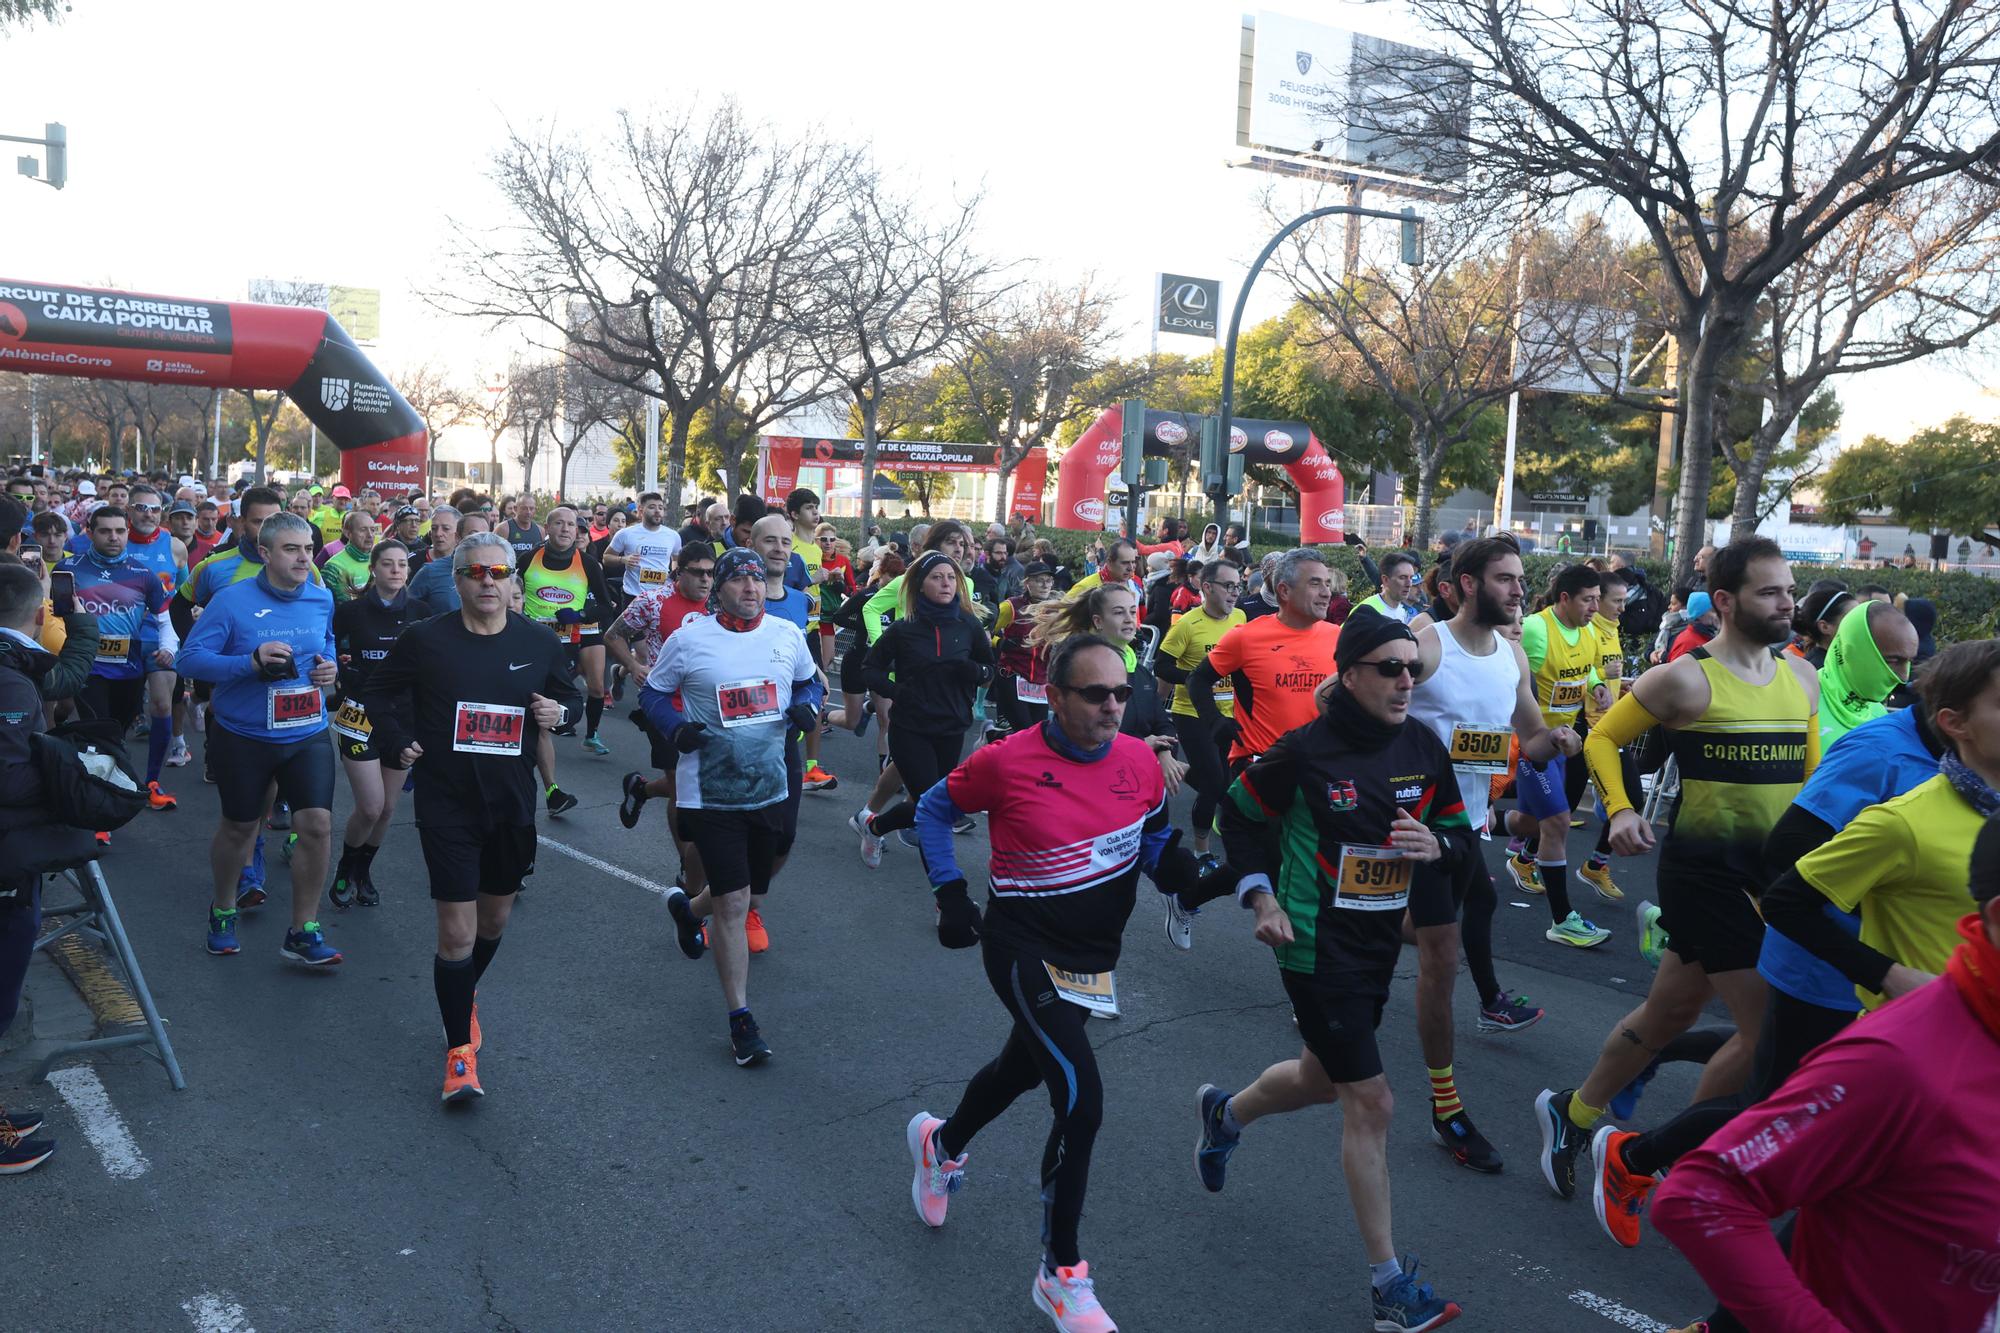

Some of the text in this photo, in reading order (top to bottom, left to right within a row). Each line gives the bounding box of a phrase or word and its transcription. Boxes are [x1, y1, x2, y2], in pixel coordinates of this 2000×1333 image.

[1280, 80, 1325, 97] PEUGEOT
[1268, 93, 1291, 106] 3008
[66, 293, 95, 307] DE
[99, 296, 210, 318] CARRERES
[42, 304, 214, 335] CAIXAPOPULAR
[1164, 316, 1214, 330] LEXUS
[165, 360, 192, 369] caixa
[164, 367, 206, 376] popular
[353, 390, 390, 400] Esportiva
[352, 397, 392, 407] Municipal
[887, 443, 899, 452] DE
[899, 444, 943, 454] CARRERES
[910, 452, 973, 463] CAIXAPOPULAR
[643, 570, 662, 580] 3473
[540, 590, 572, 600] Serrano
[270, 628, 294, 637] Running
[282, 695, 314, 712] 3124
[726, 687, 769, 709] 3045
[465, 712, 512, 735] 3044
[1458, 732, 1502, 754] 3503
[1106, 834, 1121, 845] Club
[1097, 846, 1114, 857] VON
[1354, 859, 1403, 886] 3971
